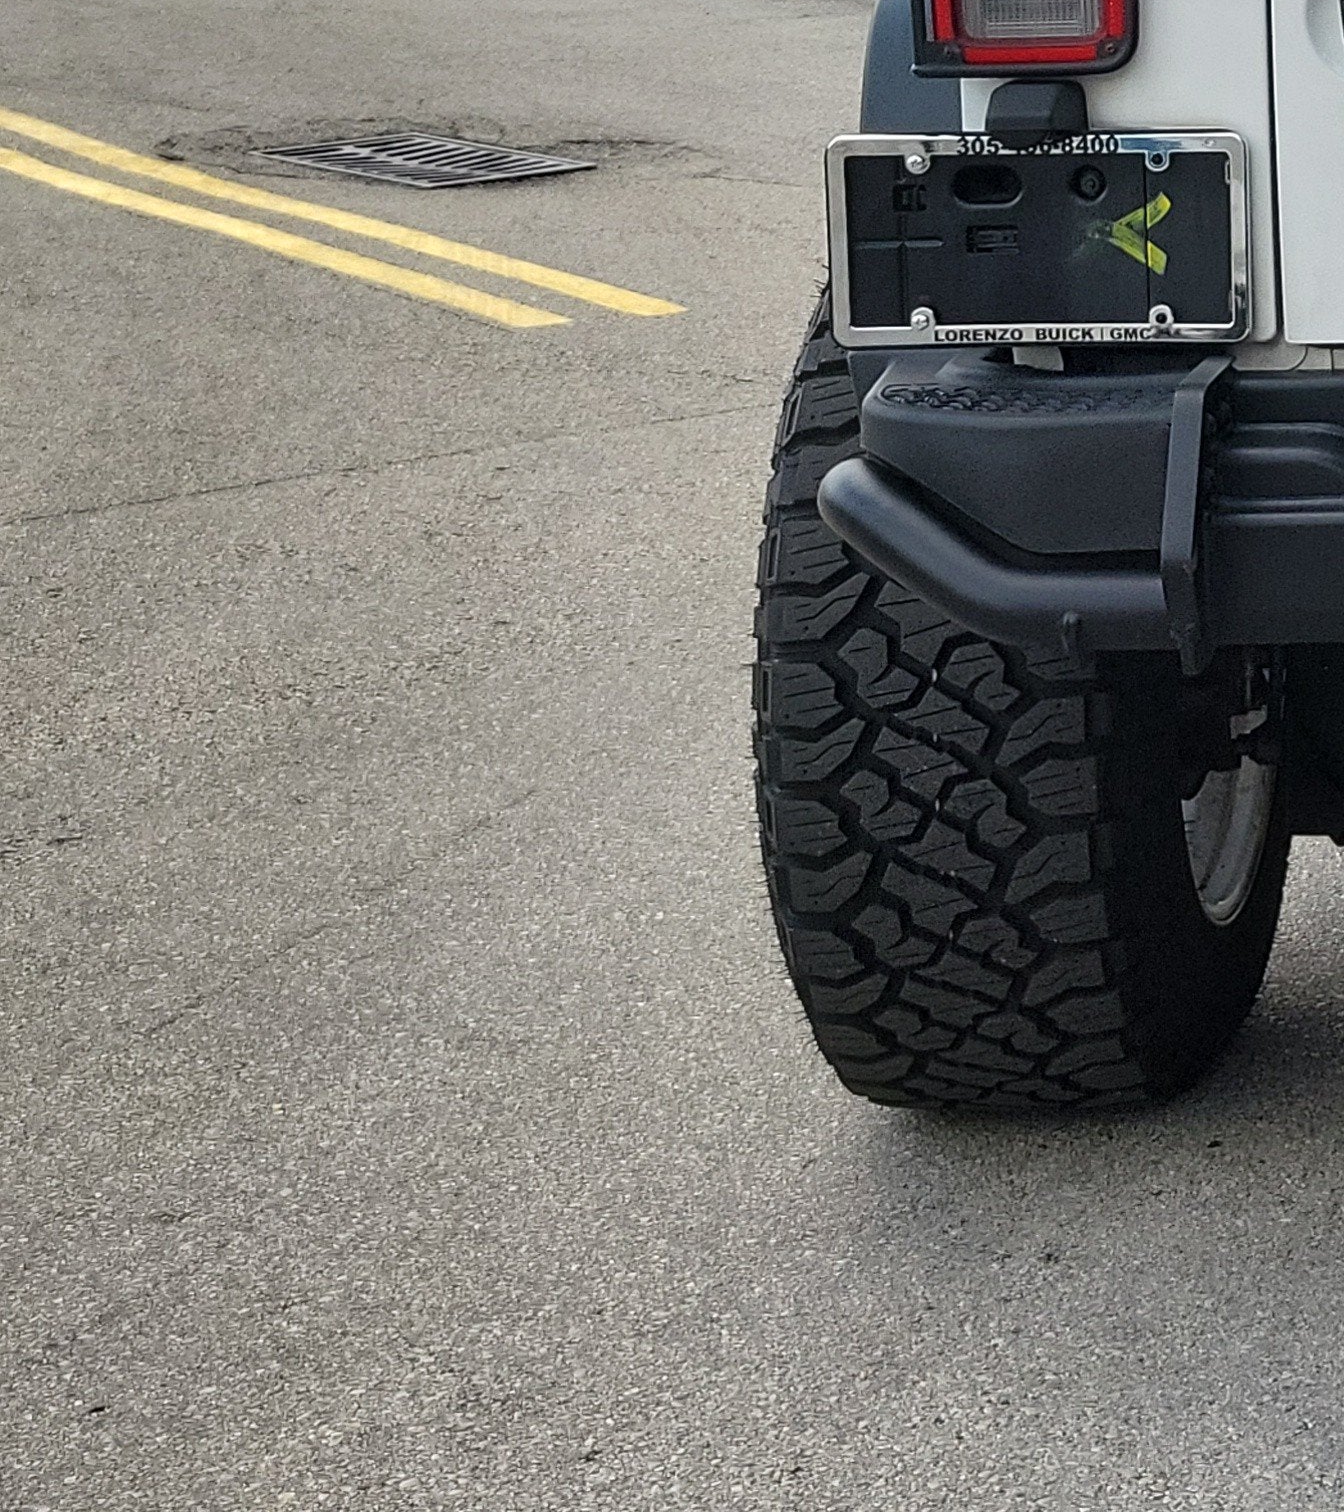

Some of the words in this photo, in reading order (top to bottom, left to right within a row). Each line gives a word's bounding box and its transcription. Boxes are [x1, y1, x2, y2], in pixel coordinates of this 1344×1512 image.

[934, 328, 1024, 343] LORENZO
[1034, 327, 1095, 342] BUICK
[1109, 327, 1152, 340] GMC
